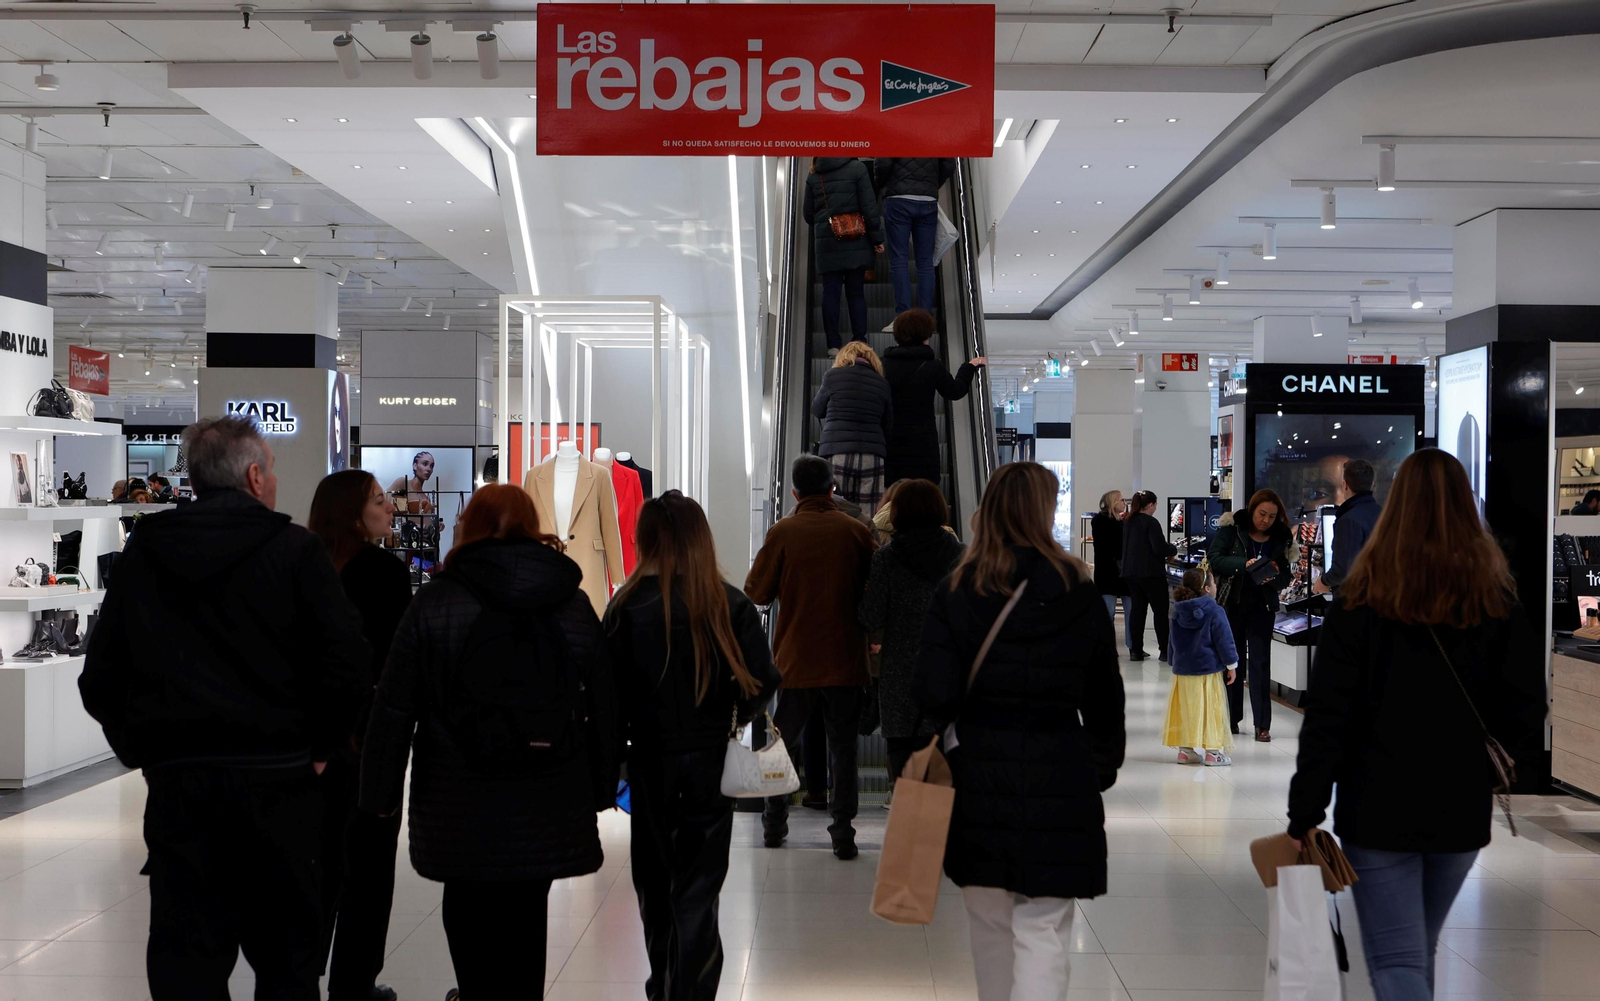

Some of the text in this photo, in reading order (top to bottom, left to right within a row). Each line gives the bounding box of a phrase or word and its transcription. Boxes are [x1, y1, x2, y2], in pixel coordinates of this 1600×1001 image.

[556, 23, 617, 54] Las
[556, 38, 866, 128] rebajas
[884, 78, 894, 90] El
[894, 79, 916, 90] Corte
[685, 140, 713, 148] QUEDA
[714, 140, 762, 148] SATISFECHO
[763, 140, 773, 148] LE
[774, 140, 827, 148] DEVOLVEMOS
[828, 140, 839, 148] SU
[840, 141, 871, 149] DINERO
[18, 333, 26, 354] Y
[26, 335, 48, 358] LOLA
[70, 356, 100, 385] rebajas
[1281, 374, 1390, 394] CHANEL
[379, 397, 457, 406] KURT GEIGER
[227, 402, 295, 423] KARL
